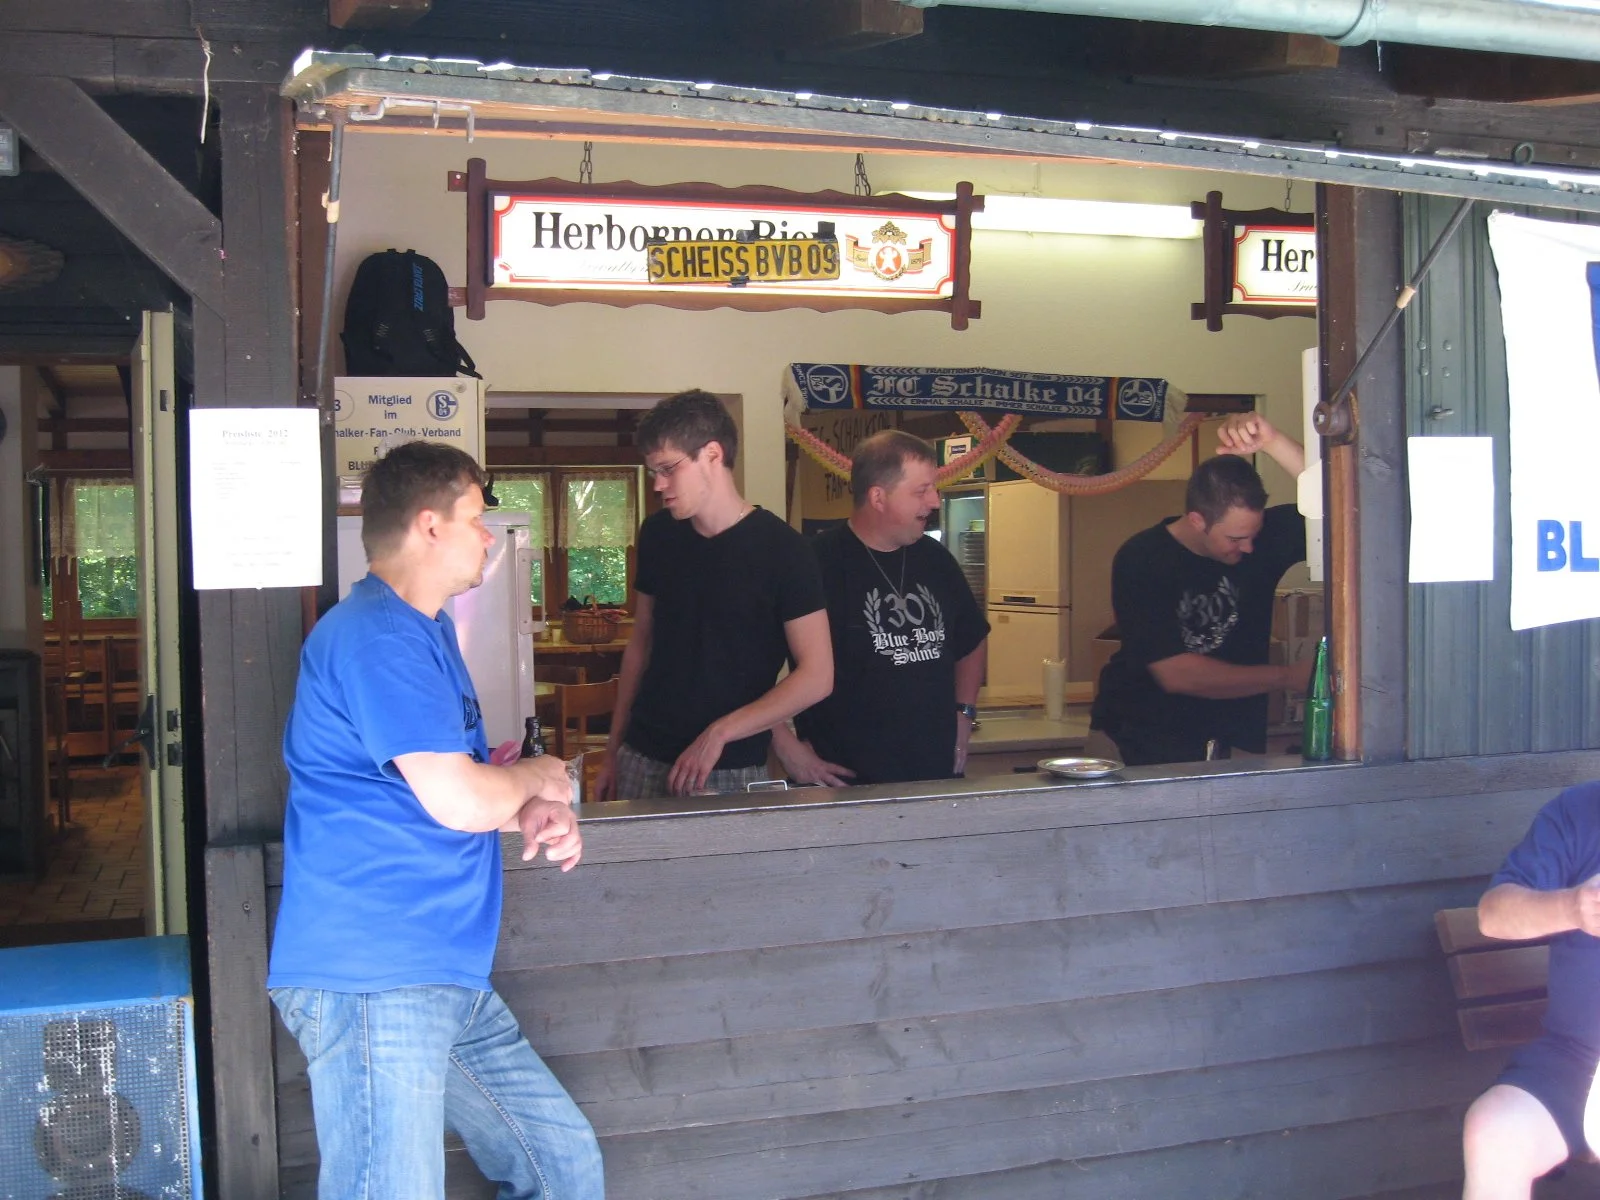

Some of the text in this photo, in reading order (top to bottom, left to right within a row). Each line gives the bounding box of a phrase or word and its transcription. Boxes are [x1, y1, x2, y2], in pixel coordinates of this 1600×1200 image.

[650, 244, 837, 278] SCHEISS BVB 09
[1260, 238, 1315, 272] Her
[368, 394, 412, 406] Mitglied
[931, 374, 1057, 403] Schalke
[1066, 385, 1103, 406] 04
[384, 410, 397, 419] im
[268, 429, 289, 438] 2012
[1537, 519, 1600, 572] BL
[884, 593, 925, 628] 30
[892, 647, 941, 666] Solms
